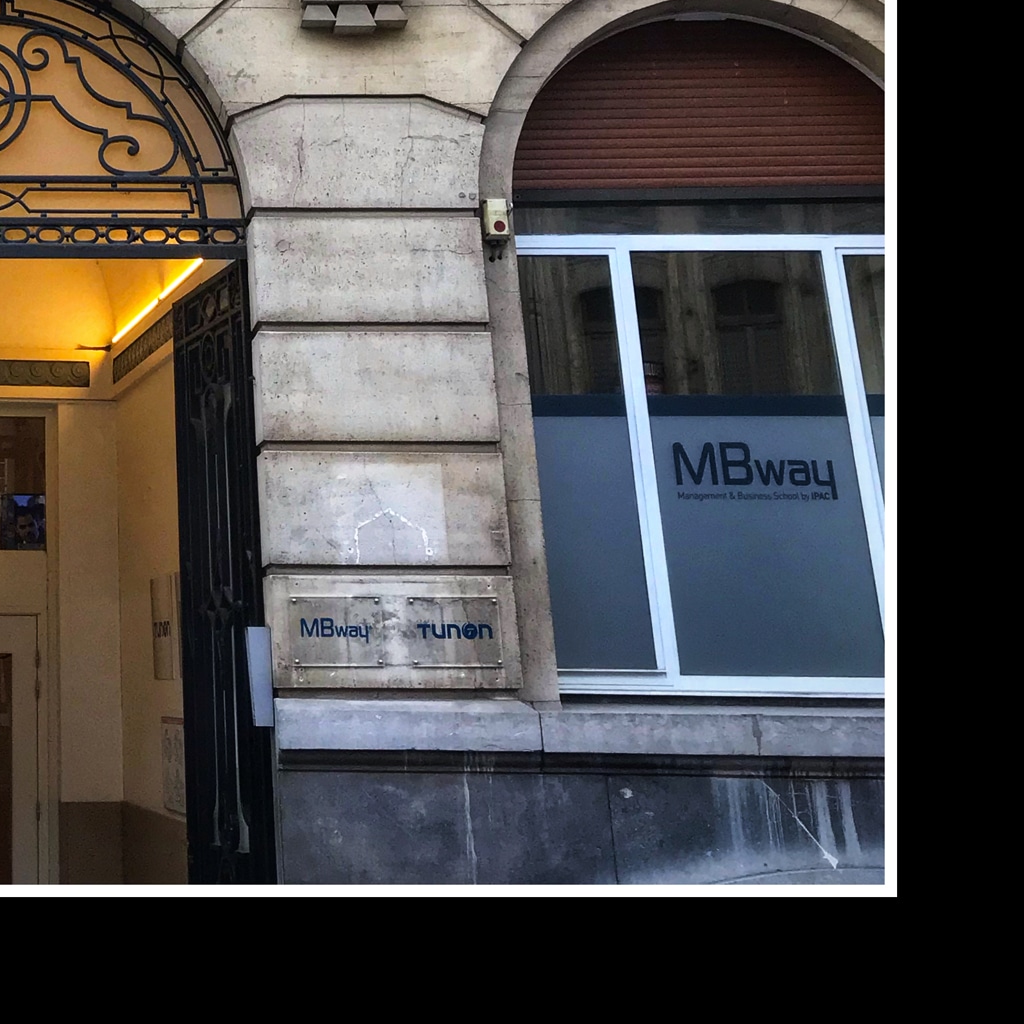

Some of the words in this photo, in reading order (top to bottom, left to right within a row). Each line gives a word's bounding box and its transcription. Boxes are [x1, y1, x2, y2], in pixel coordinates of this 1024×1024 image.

[672, 441, 838, 500] MBway
[677, 492, 727, 501] Management
[737, 492, 772, 500] Business
[773, 492, 799, 501] School
[801, 493, 809, 502] by
[810, 492, 831, 501] IPAC
[300, 618, 369, 643] MBway
